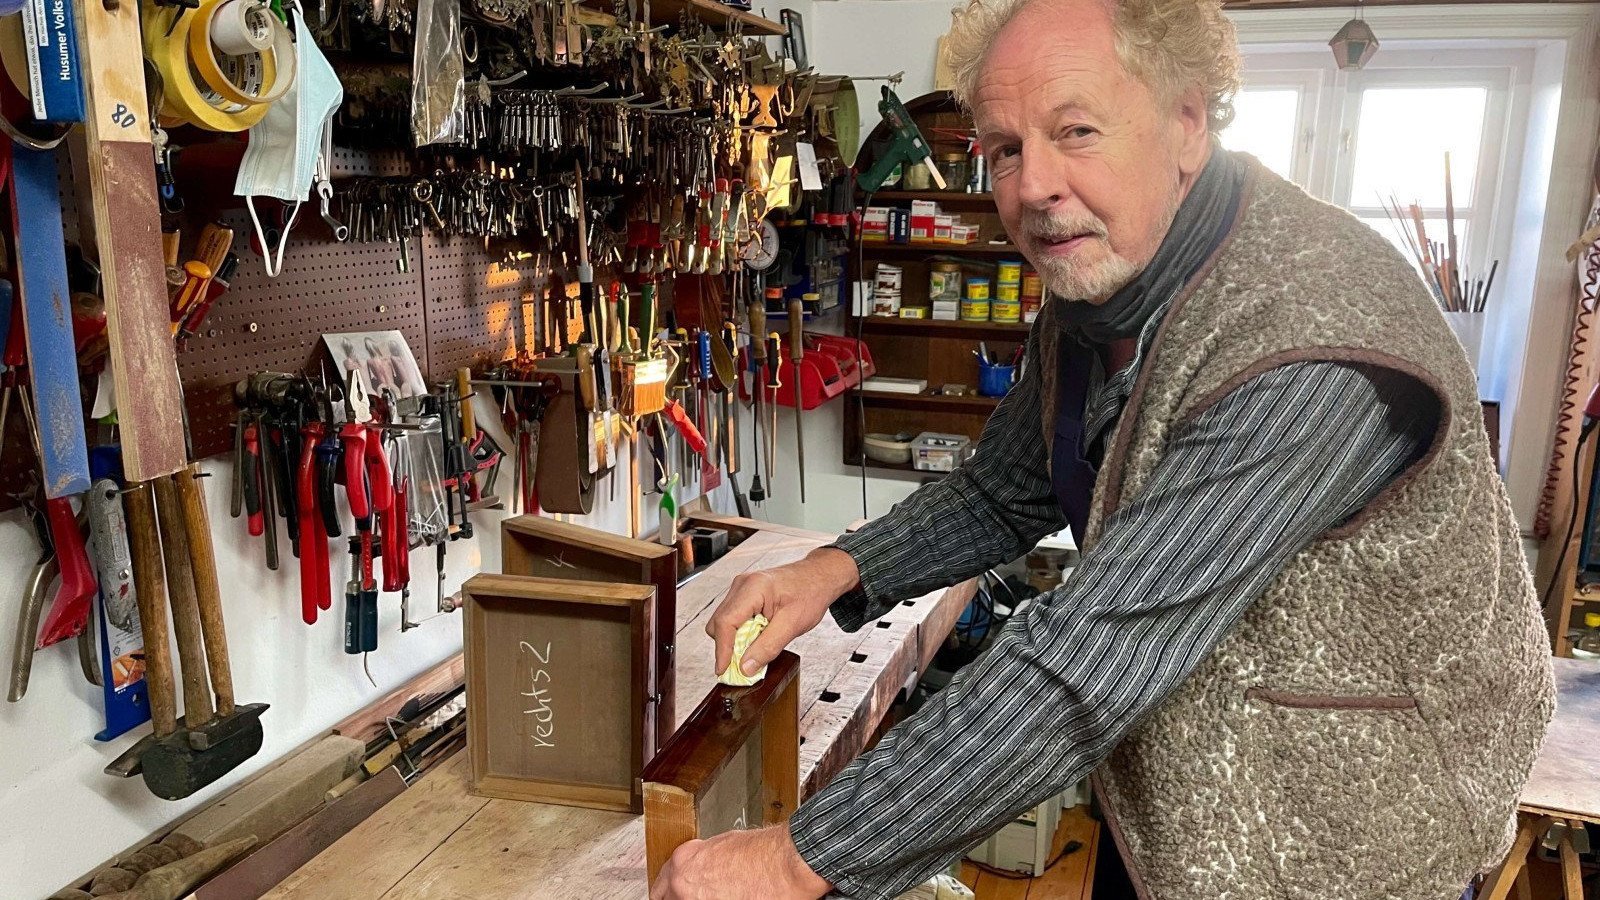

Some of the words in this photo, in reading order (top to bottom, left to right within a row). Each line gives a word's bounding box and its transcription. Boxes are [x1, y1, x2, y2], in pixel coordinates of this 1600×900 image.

[52, 0, 65, 29] Volks
[58, 31, 71, 80] Husumer
[249, 64, 255, 77] 3M
[111, 103, 136, 128] 80
[519, 640, 551, 664] 2
[520, 666, 555, 747] rechts
